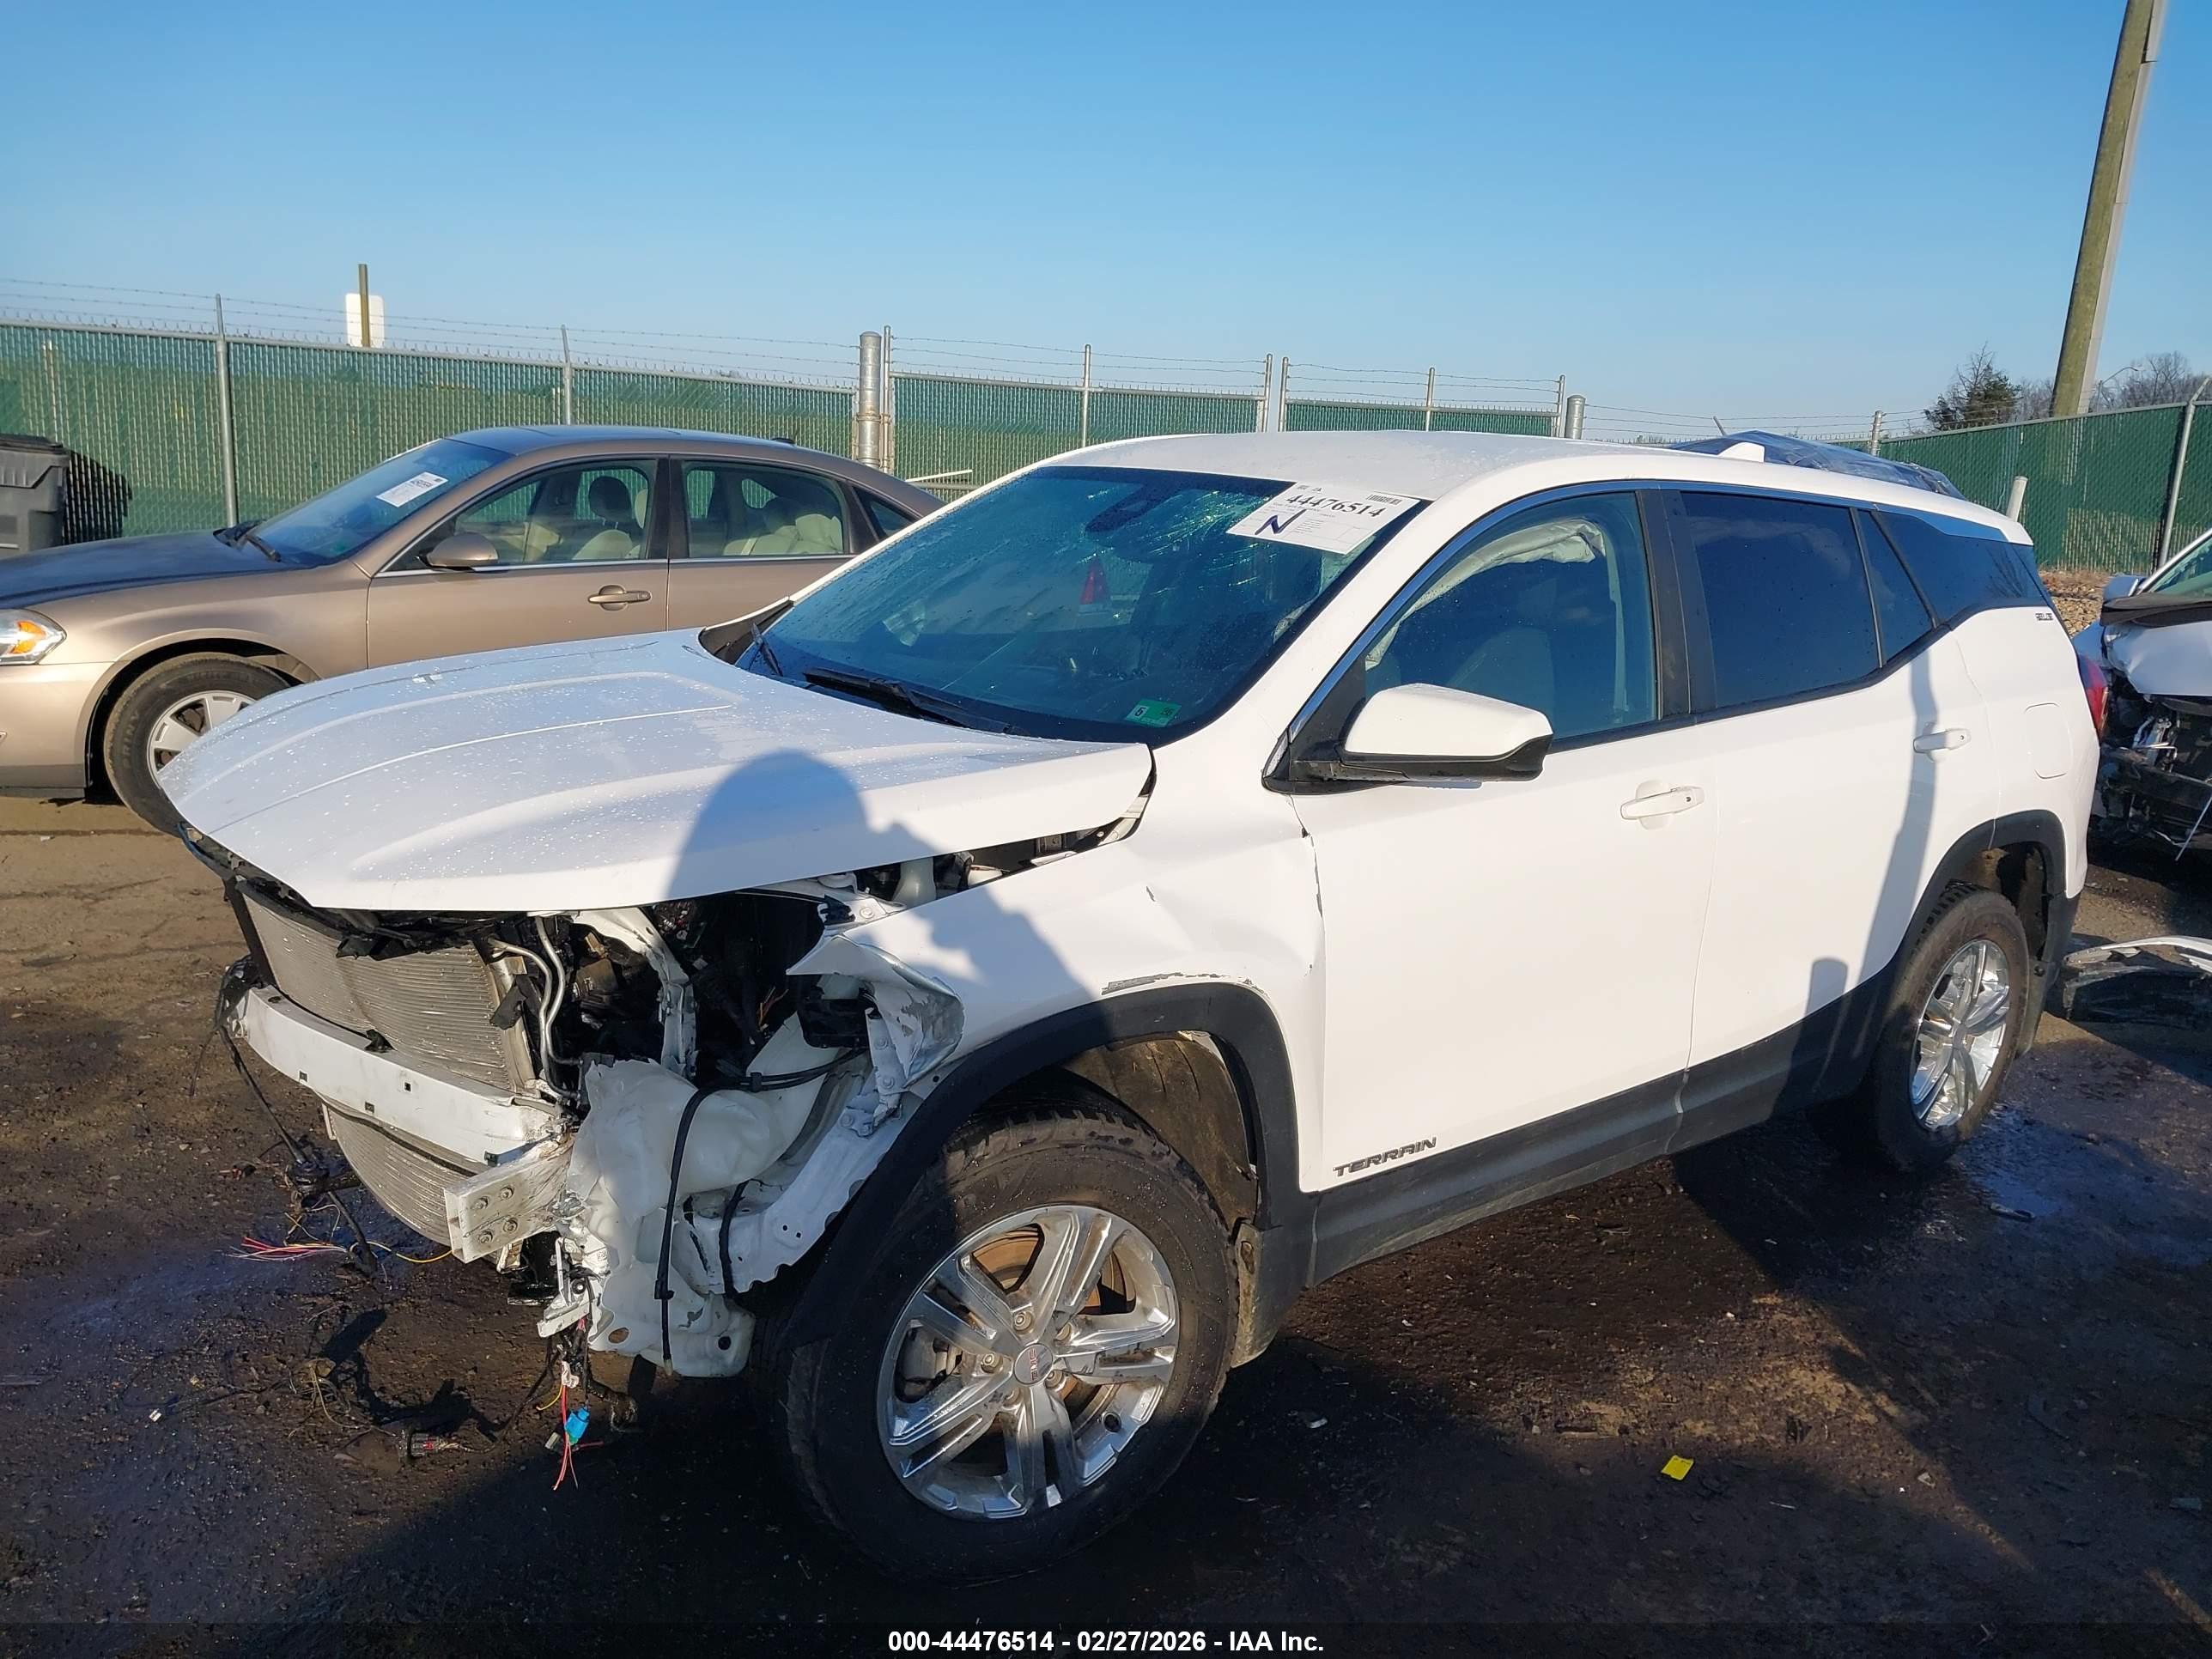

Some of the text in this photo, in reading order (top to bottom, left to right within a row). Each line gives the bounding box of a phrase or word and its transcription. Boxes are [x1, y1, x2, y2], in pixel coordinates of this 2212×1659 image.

[1285, 494, 1387, 518] 44476514
[1255, 508, 1307, 535] N
[1333, 1137, 1437, 1176] TERRAIN
